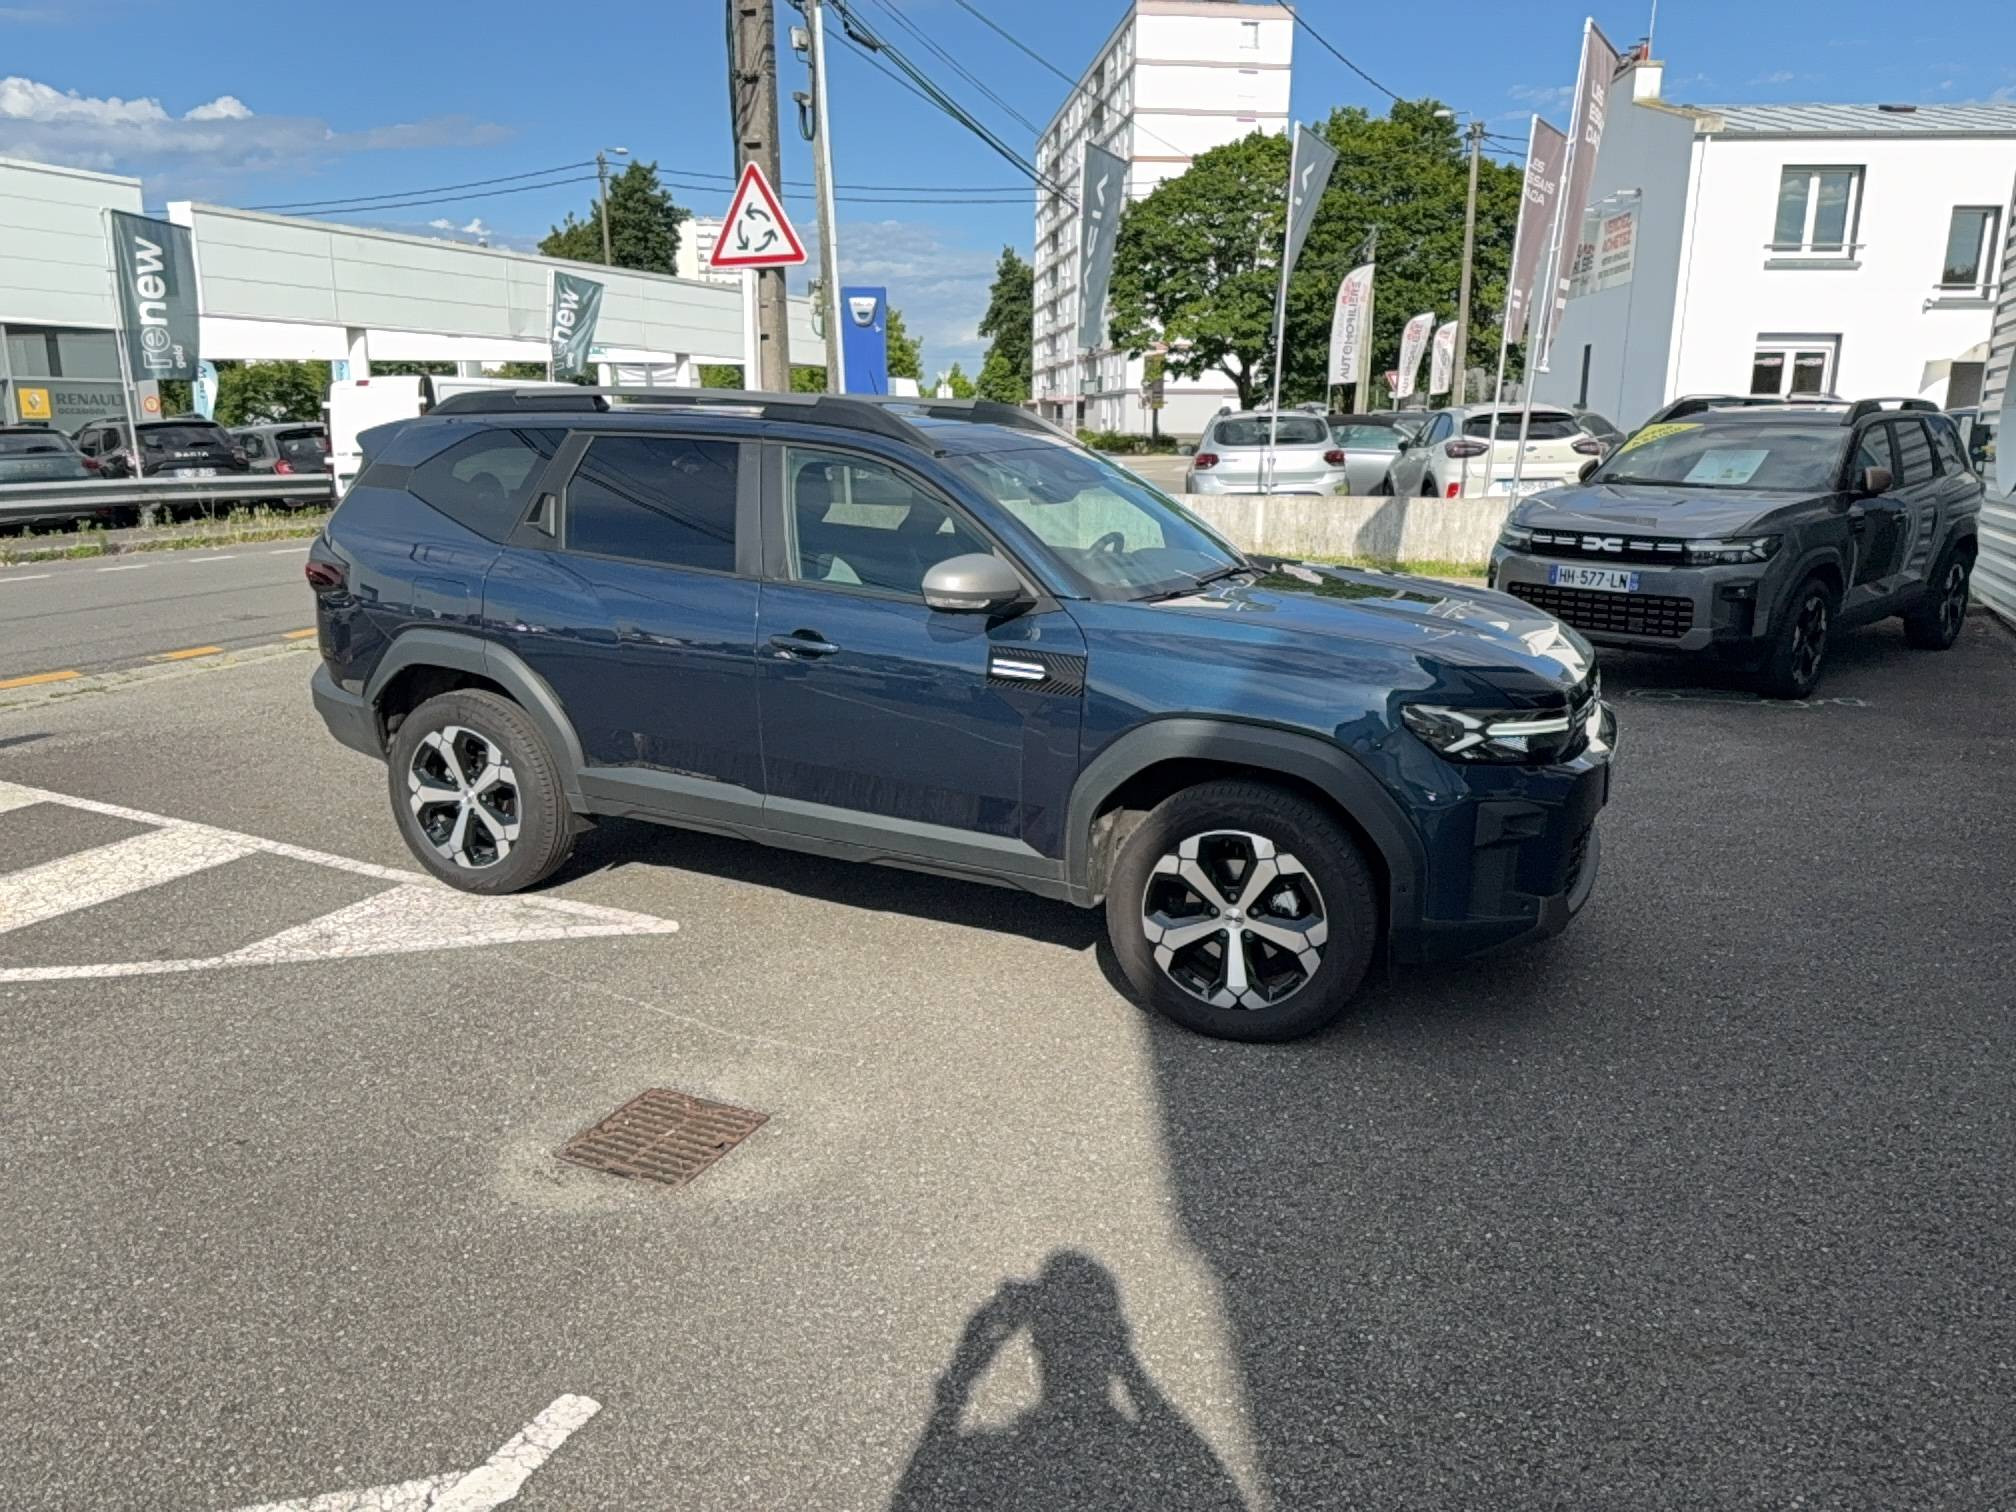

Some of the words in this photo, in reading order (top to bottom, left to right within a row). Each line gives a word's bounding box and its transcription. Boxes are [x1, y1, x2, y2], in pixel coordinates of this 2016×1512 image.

[135, 235, 173, 369] renew
[173, 344, 187, 369] gold
[1559, 568, 1629, 589] HH-577-LN
